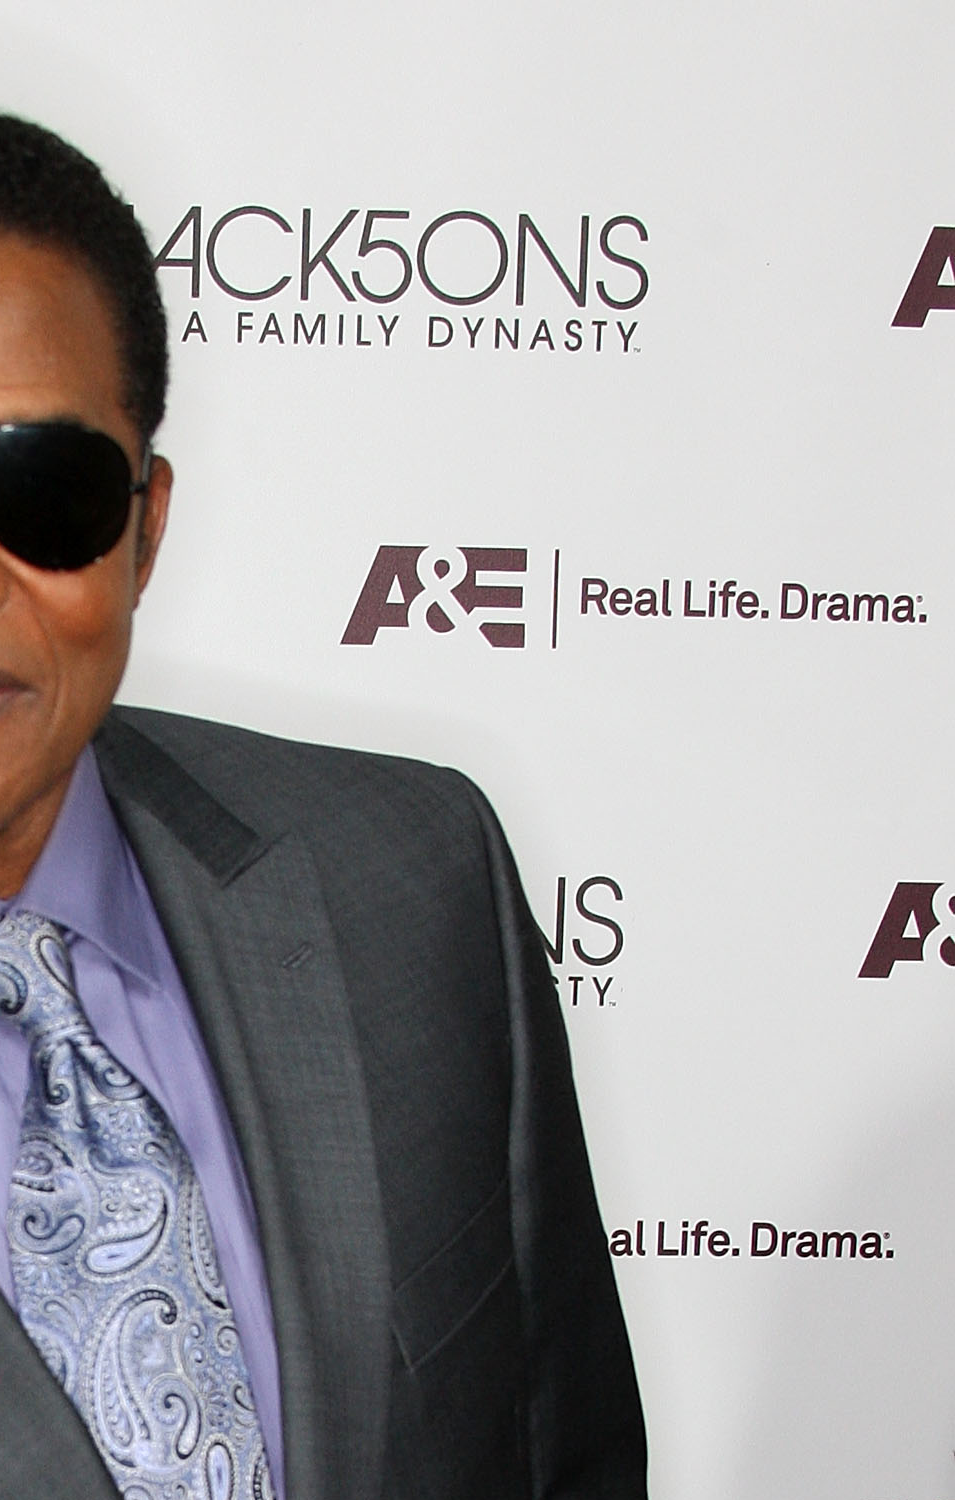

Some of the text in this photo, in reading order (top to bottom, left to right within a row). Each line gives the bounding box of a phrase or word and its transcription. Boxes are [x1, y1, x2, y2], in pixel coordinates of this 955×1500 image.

[125, 205, 649, 309] ACK5ONS
[182, 311, 637, 352] A FAMILY DYNASTY
[340, 545, 527, 648] A&E
[581, 578, 671, 616] Real
[684, 581, 769, 618] Life.
[858, 882, 955, 977] A
[658, 1221, 739, 1256] Life.
